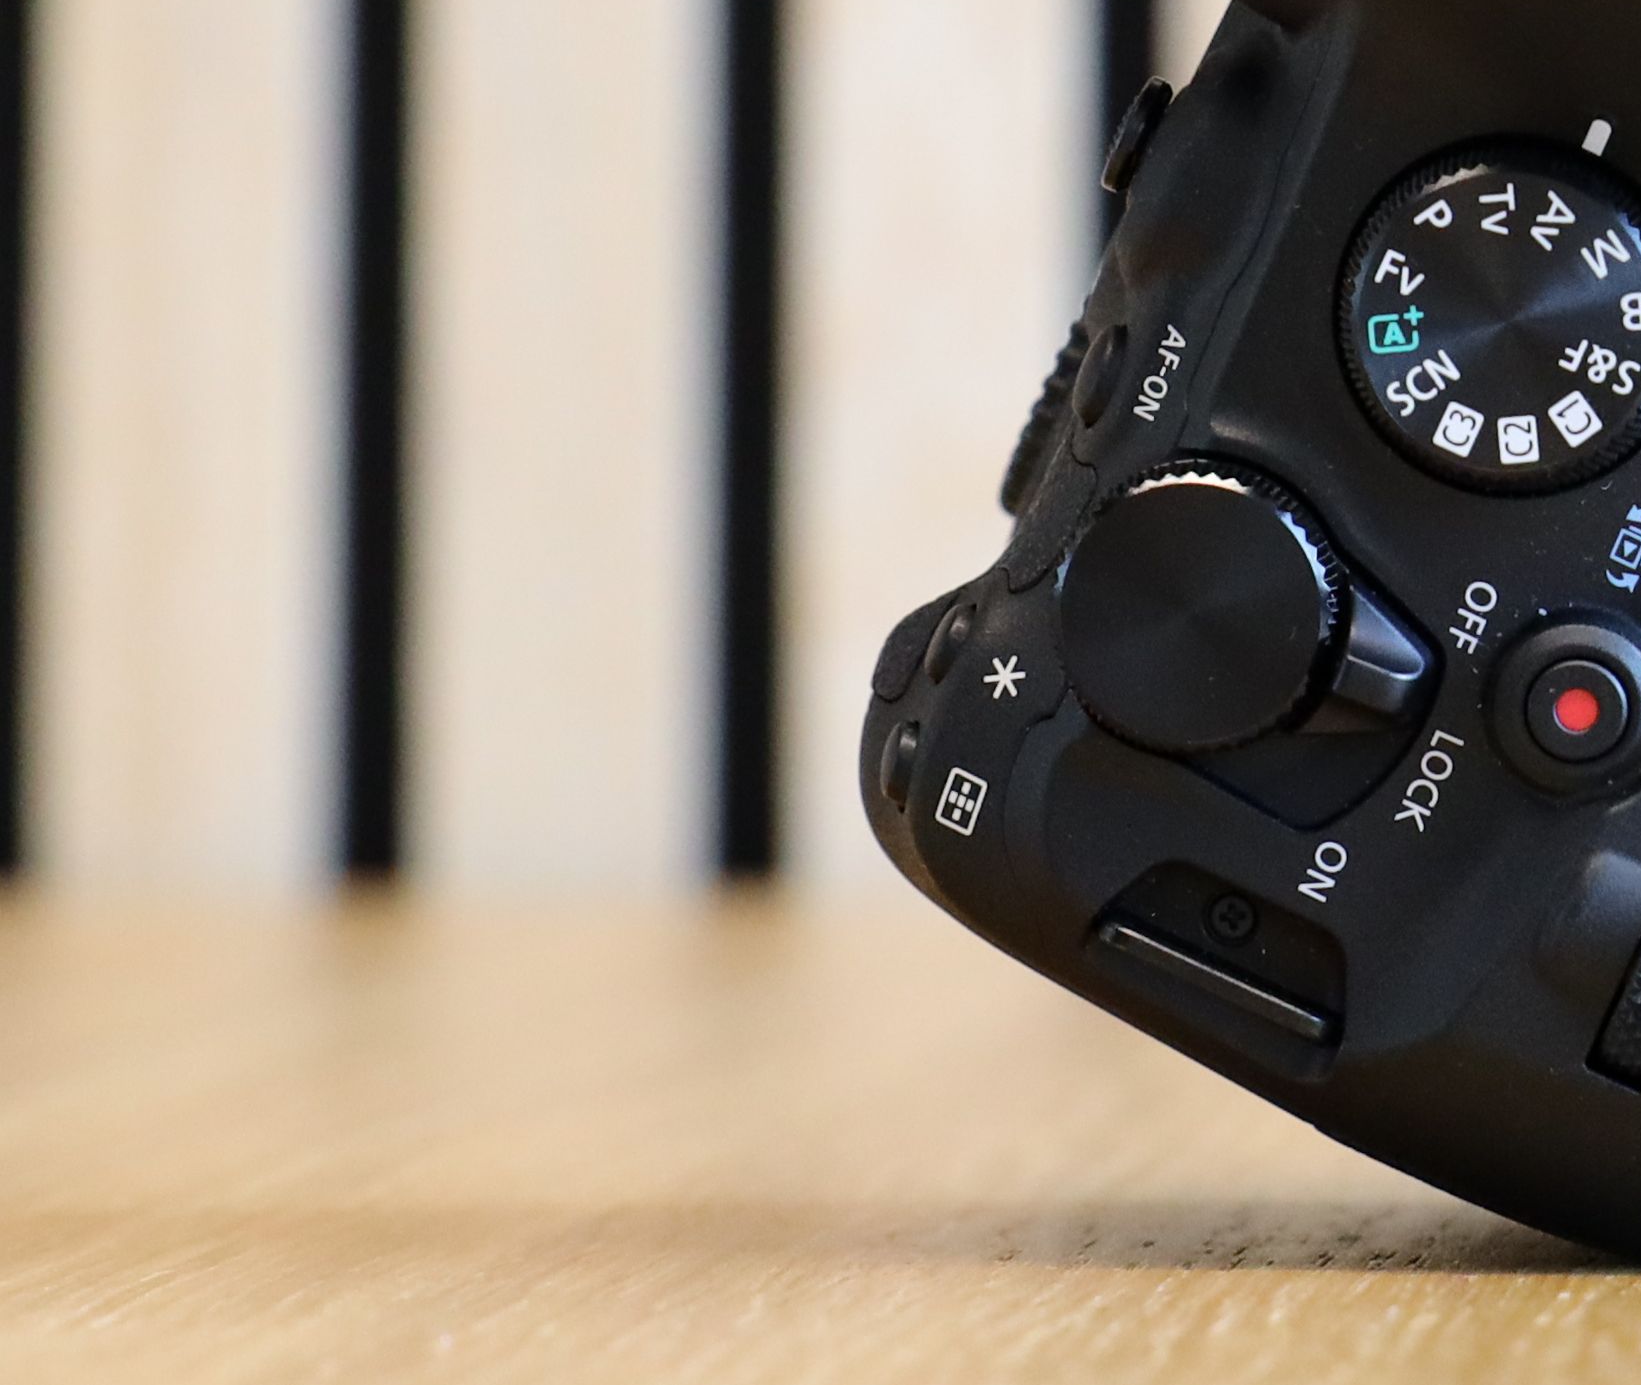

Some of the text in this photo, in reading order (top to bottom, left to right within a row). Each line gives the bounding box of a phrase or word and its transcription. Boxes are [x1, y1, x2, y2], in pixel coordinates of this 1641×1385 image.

[1413, 199, 1454, 229] P
[1580, 229, 1632, 280] M
[1132, 323, 1187, 422] AF-ON
[1386, 349, 1462, 417] SCN
[1558, 339, 1641, 396] S&F
[1441, 409, 1477, 447] C3
[1502, 419, 1534, 457] C2
[1555, 398, 1593, 436] C1
[1449, 581, 1498, 655] OFF
[1393, 728, 1466, 833] LOCK
[1297, 841, 1348, 904] ON
